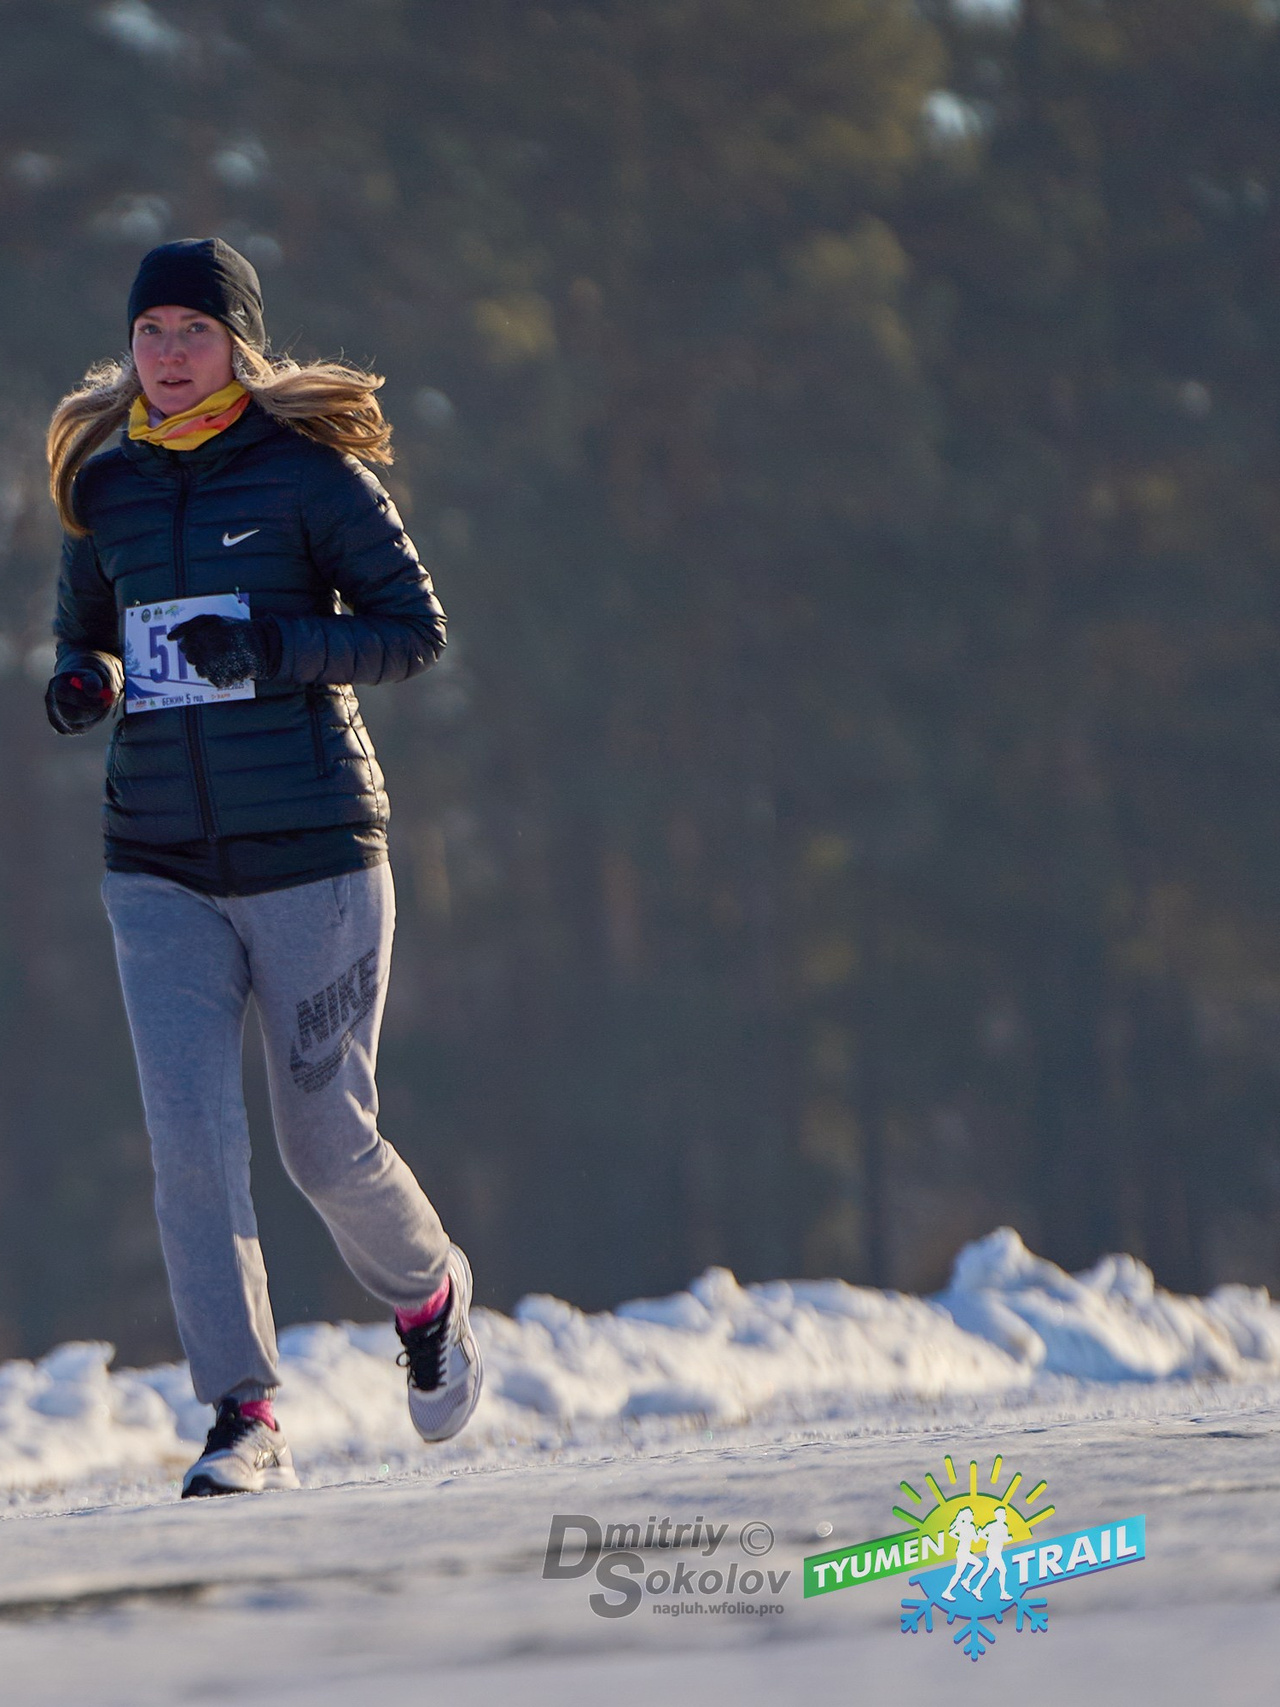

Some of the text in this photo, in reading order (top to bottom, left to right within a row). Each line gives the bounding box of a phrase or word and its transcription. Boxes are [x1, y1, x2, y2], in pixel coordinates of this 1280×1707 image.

[149, 623, 188, 683] 51
[162, 695, 185, 707] БЕЖИМ
[186, 693, 191, 704] 5
[193, 694, 205, 703] год
[296, 947, 379, 1053] NIKE
